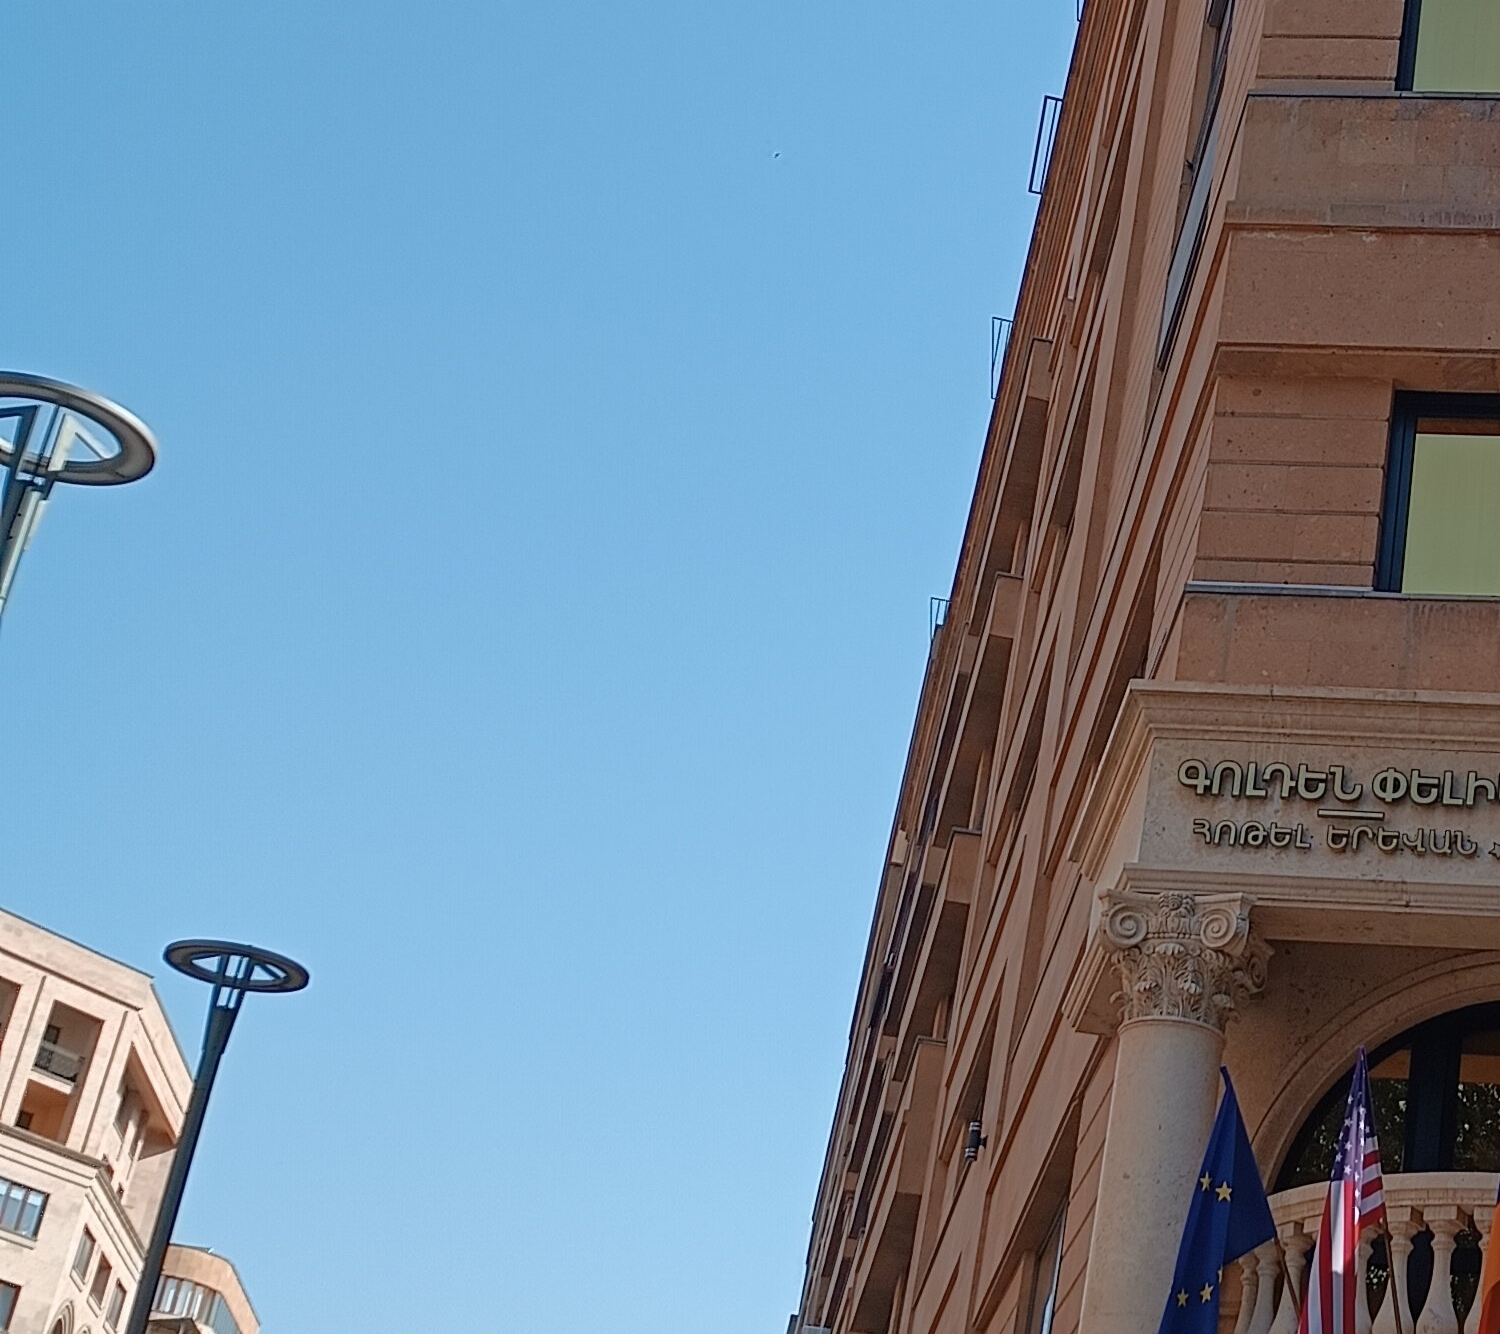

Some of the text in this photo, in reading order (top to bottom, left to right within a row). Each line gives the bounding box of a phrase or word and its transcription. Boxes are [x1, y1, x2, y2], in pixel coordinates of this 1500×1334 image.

[1178, 758, 1363, 801] ԳՈԼԴԵՆ
[1193, 818, 1479, 856] ՀՈԹԵԼ ԵՐԵՎԱՆ
